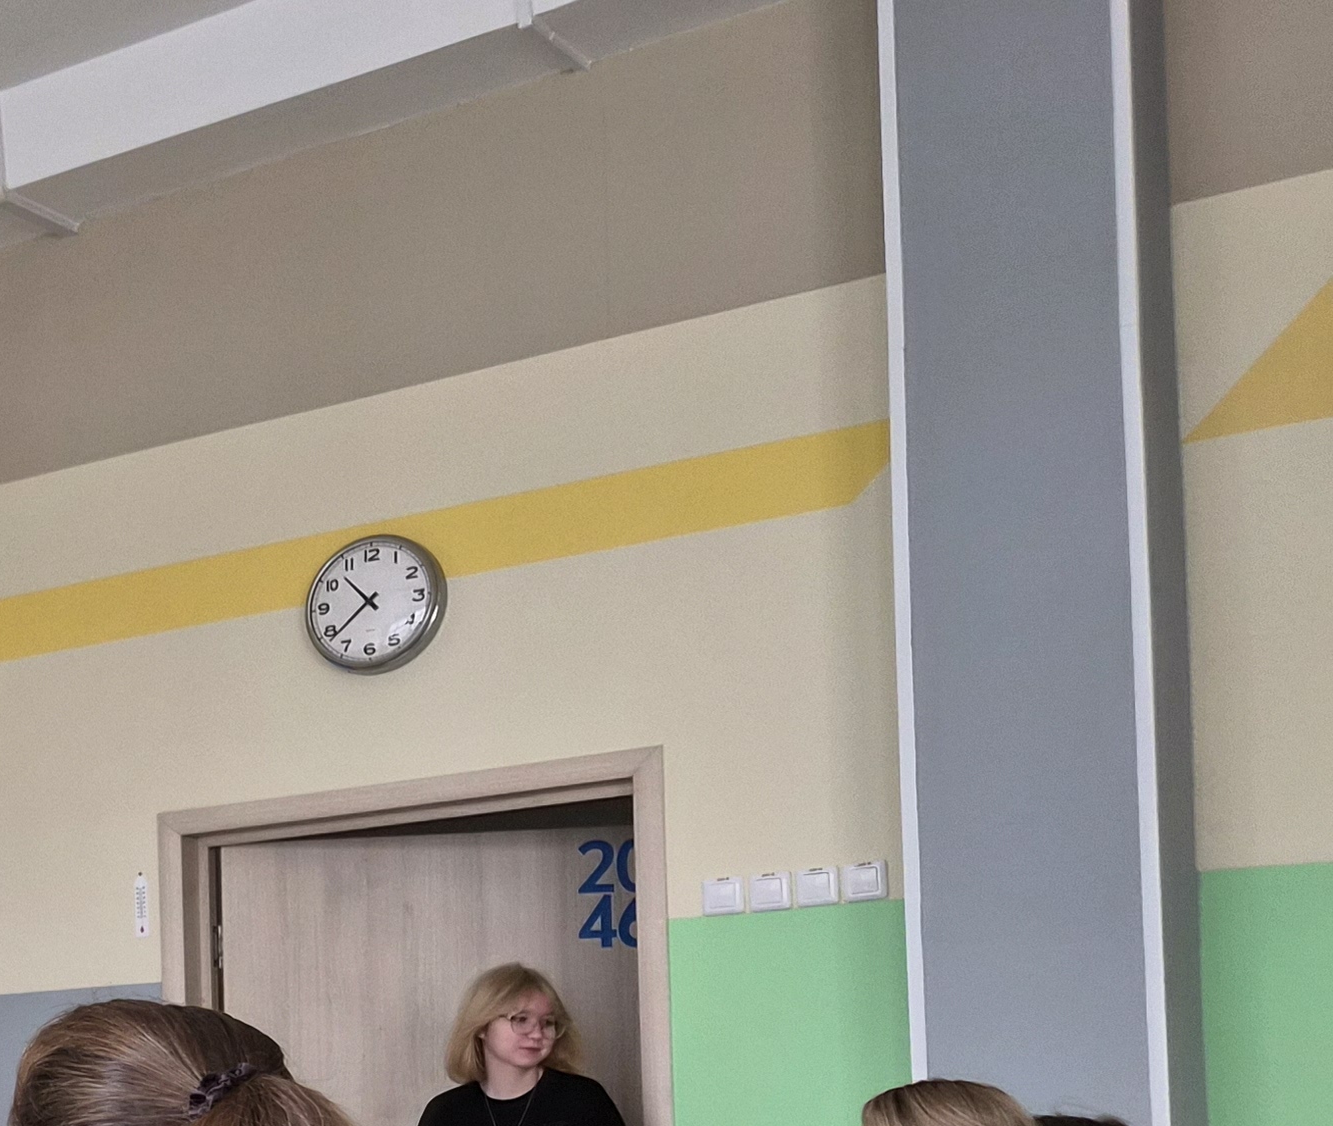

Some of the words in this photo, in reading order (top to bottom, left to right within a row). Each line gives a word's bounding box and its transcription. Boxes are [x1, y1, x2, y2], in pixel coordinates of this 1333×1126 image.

[364, 548, 380, 563] 12
[394, 551, 398, 564] 1
[344, 557, 354, 572] 11
[405, 566, 418, 580] 2
[326, 578, 339, 592] 10
[412, 588, 425, 602] 3
[318, 603, 330, 615] 9
[323, 624, 338, 638] 8
[341, 639, 352, 653] 7
[388, 633, 401, 647] 5
[363, 642, 376, 656] 6
